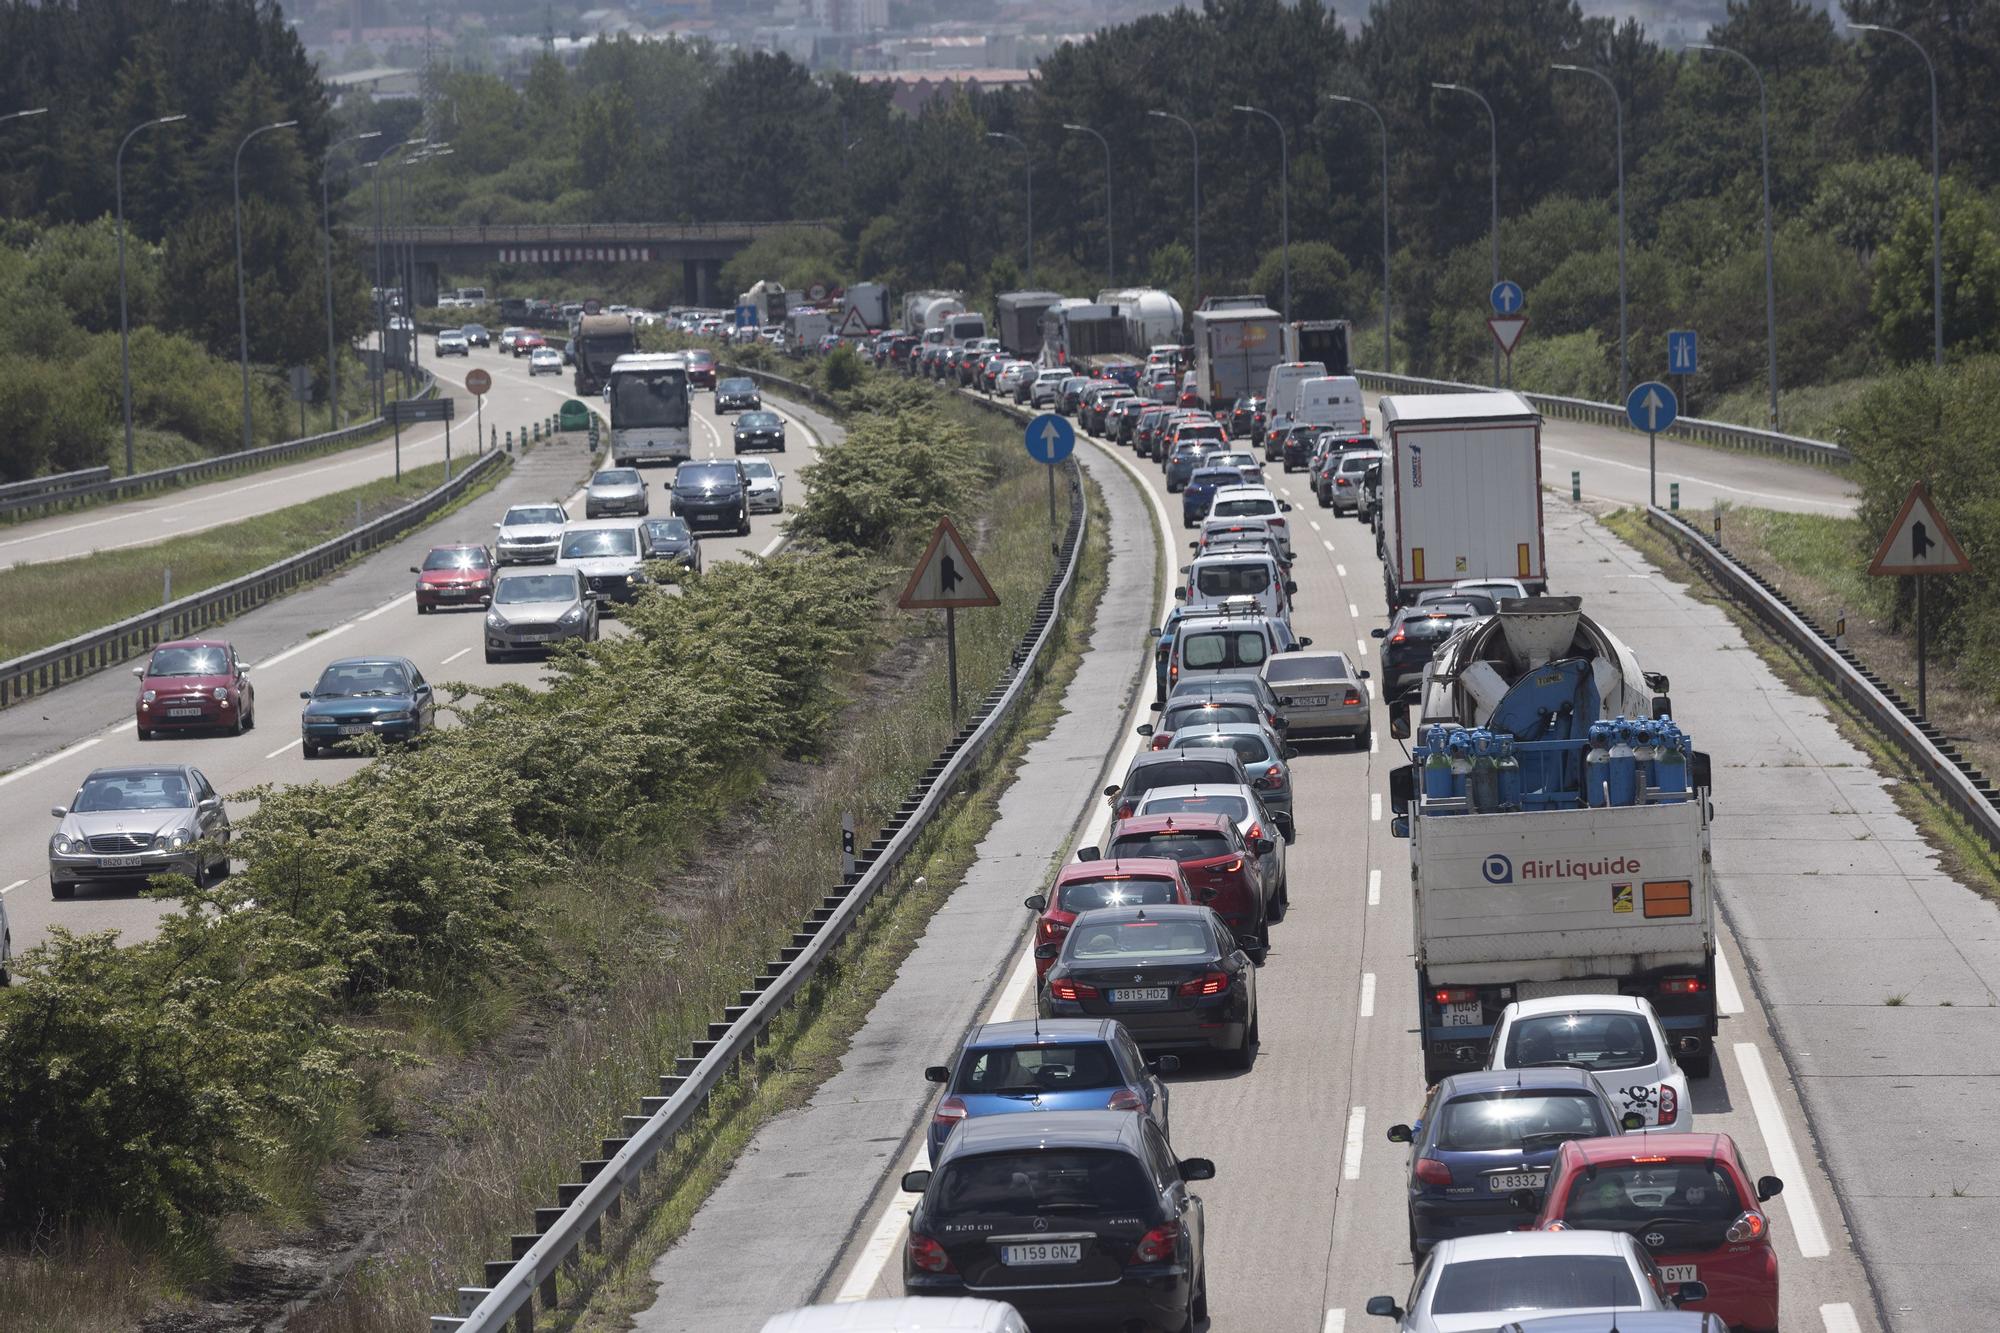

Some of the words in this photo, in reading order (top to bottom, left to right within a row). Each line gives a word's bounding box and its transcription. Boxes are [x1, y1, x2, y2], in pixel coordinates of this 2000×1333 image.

[1521, 856, 1641, 880] AirLiquide
[1116, 989, 1143, 1000] 3815
[1146, 988, 1167, 999] HDZ
[1452, 1001, 1478, 1012] 1048
[1452, 1014, 1472, 1025] FGL
[1013, 1246, 1047, 1261] 1159
[1051, 1245, 1078, 1259] GNZ
[1666, 1266, 1693, 1281] GYY
